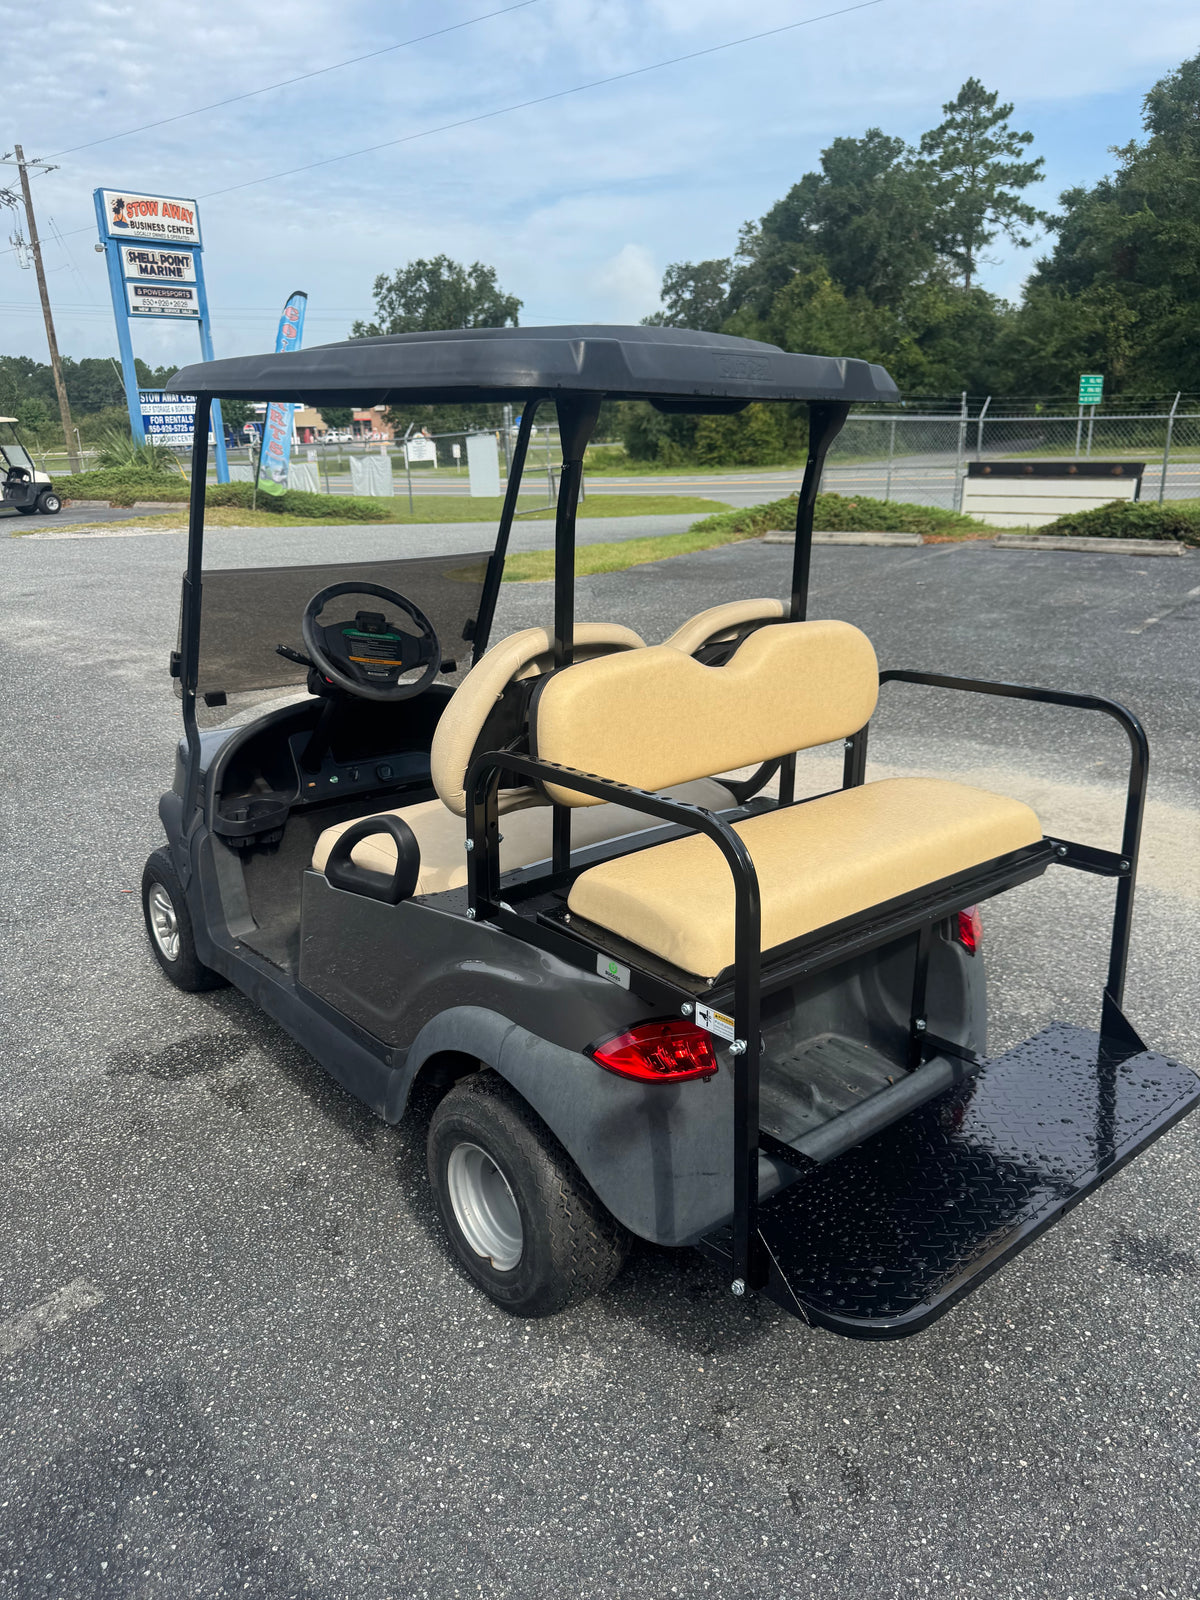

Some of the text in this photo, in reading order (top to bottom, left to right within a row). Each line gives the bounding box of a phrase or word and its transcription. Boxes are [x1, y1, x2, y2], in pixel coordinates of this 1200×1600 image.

[126, 201, 194, 225] STOW AWAY
[130, 220, 195, 236] BUSINESS CENTER
[128, 251, 190, 267] SHELL POINT
[139, 264, 183, 277] MARINE
[143, 288, 190, 298] POWERSPORTS
[140, 392, 160, 402] STOW
[150, 415, 194, 425] FOR RENTALS
